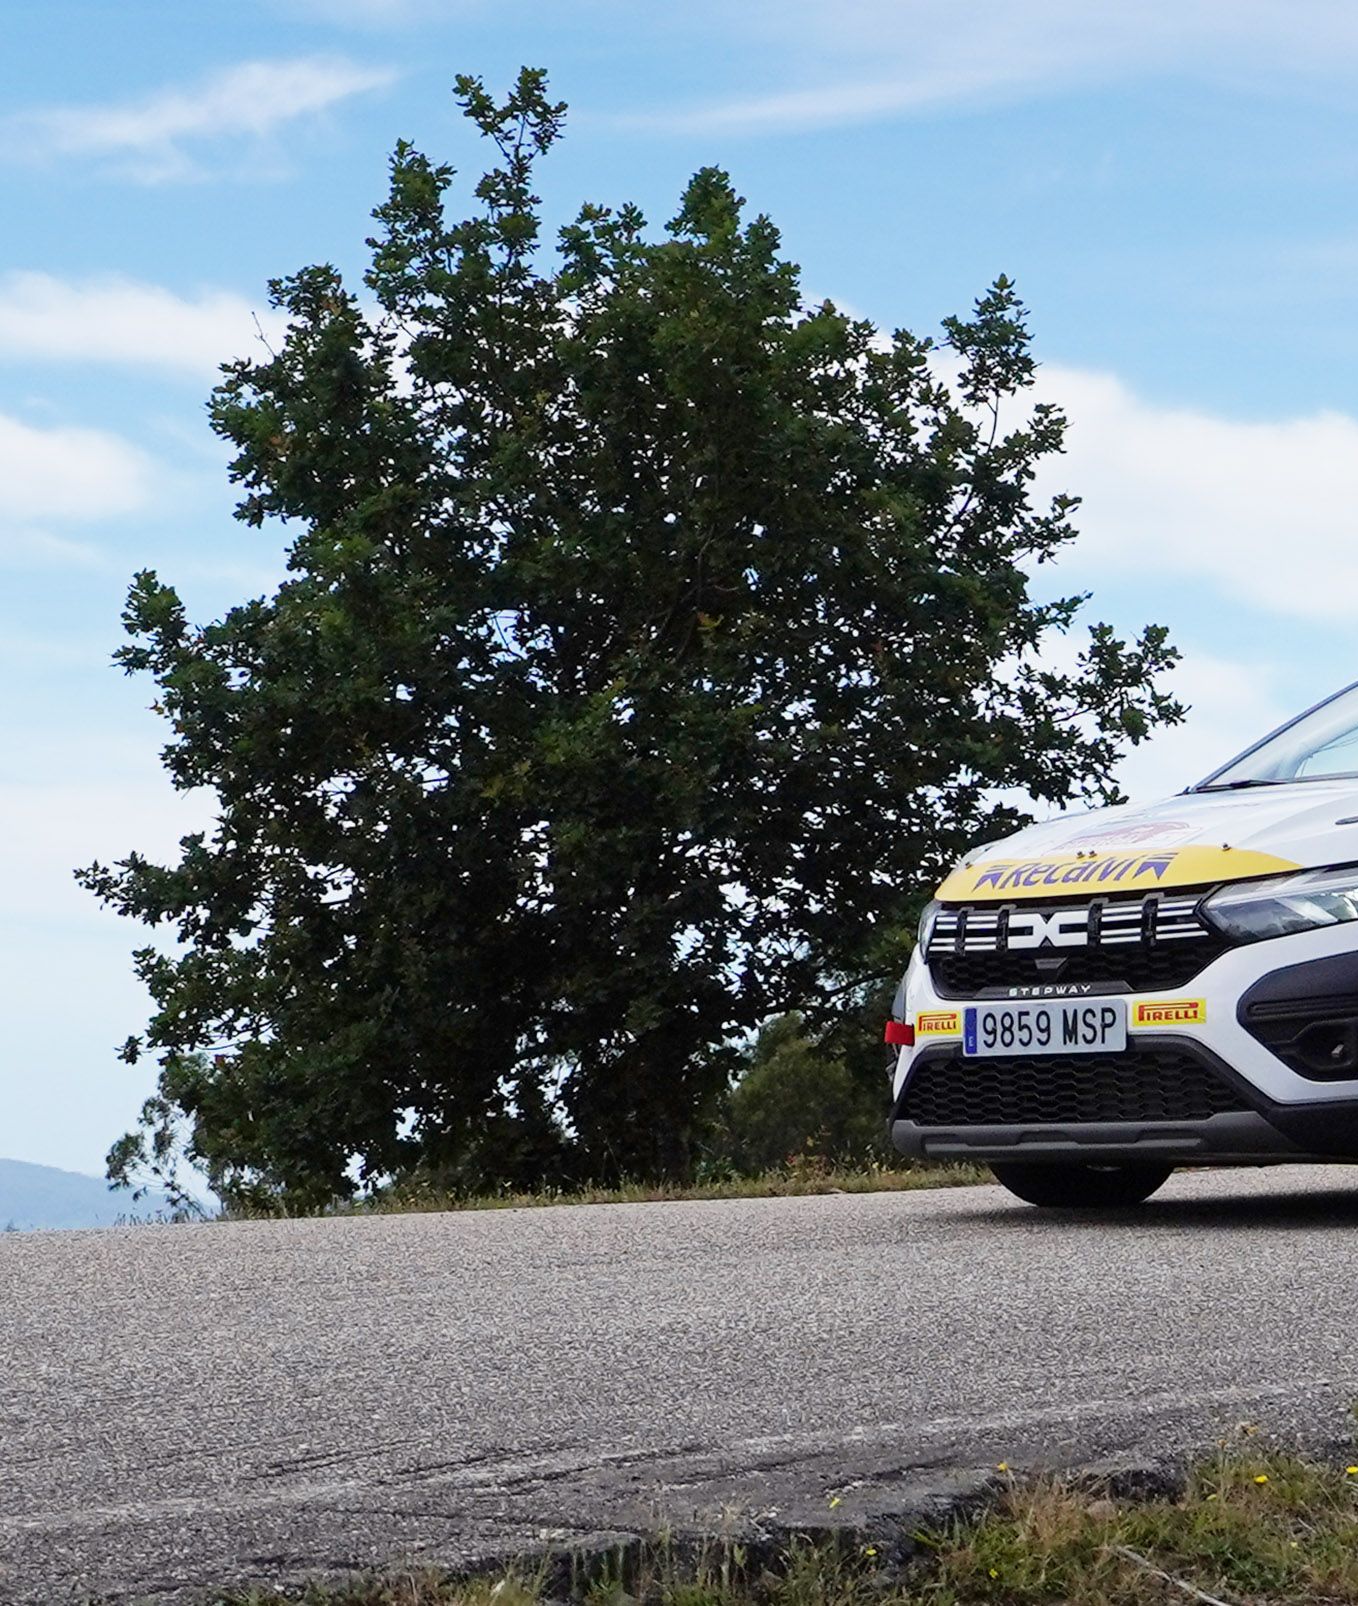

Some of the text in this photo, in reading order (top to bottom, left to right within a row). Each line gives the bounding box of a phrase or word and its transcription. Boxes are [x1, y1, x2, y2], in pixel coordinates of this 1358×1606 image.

[1009, 983, 1093, 997] STEPWAY
[1138, 1001, 1199, 1021] PIRELLI
[918, 1014, 957, 1032] PIRELLI
[982, 1007, 1118, 1048] 9859 MSP
